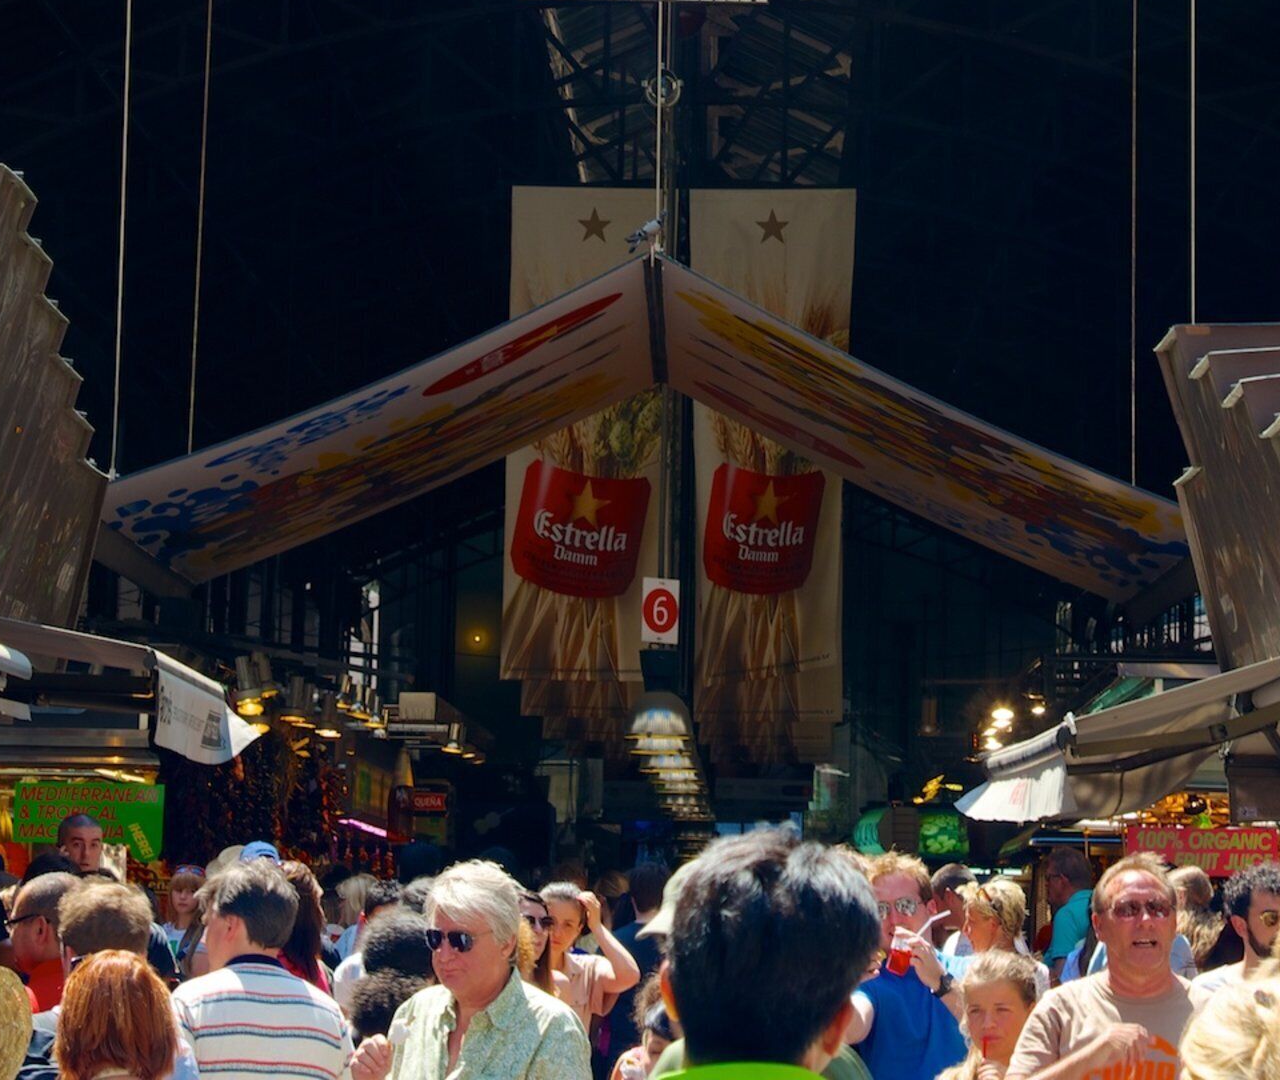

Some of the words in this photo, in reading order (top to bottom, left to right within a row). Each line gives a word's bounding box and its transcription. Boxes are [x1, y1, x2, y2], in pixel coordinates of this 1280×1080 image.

[533, 508, 628, 552] Estrella
[722, 511, 806, 548] Estrella
[552, 543, 598, 567] Damm
[737, 544, 780, 563] Damm
[652, 595, 669, 626] 6
[20, 786, 159, 803] MEDITERRANEAN
[19, 805, 30, 819] &
[1136, 831, 1185, 849] 100%
[1188, 831, 1273, 851] ORGANIC
[1174, 852, 1221, 871] FRUIT
